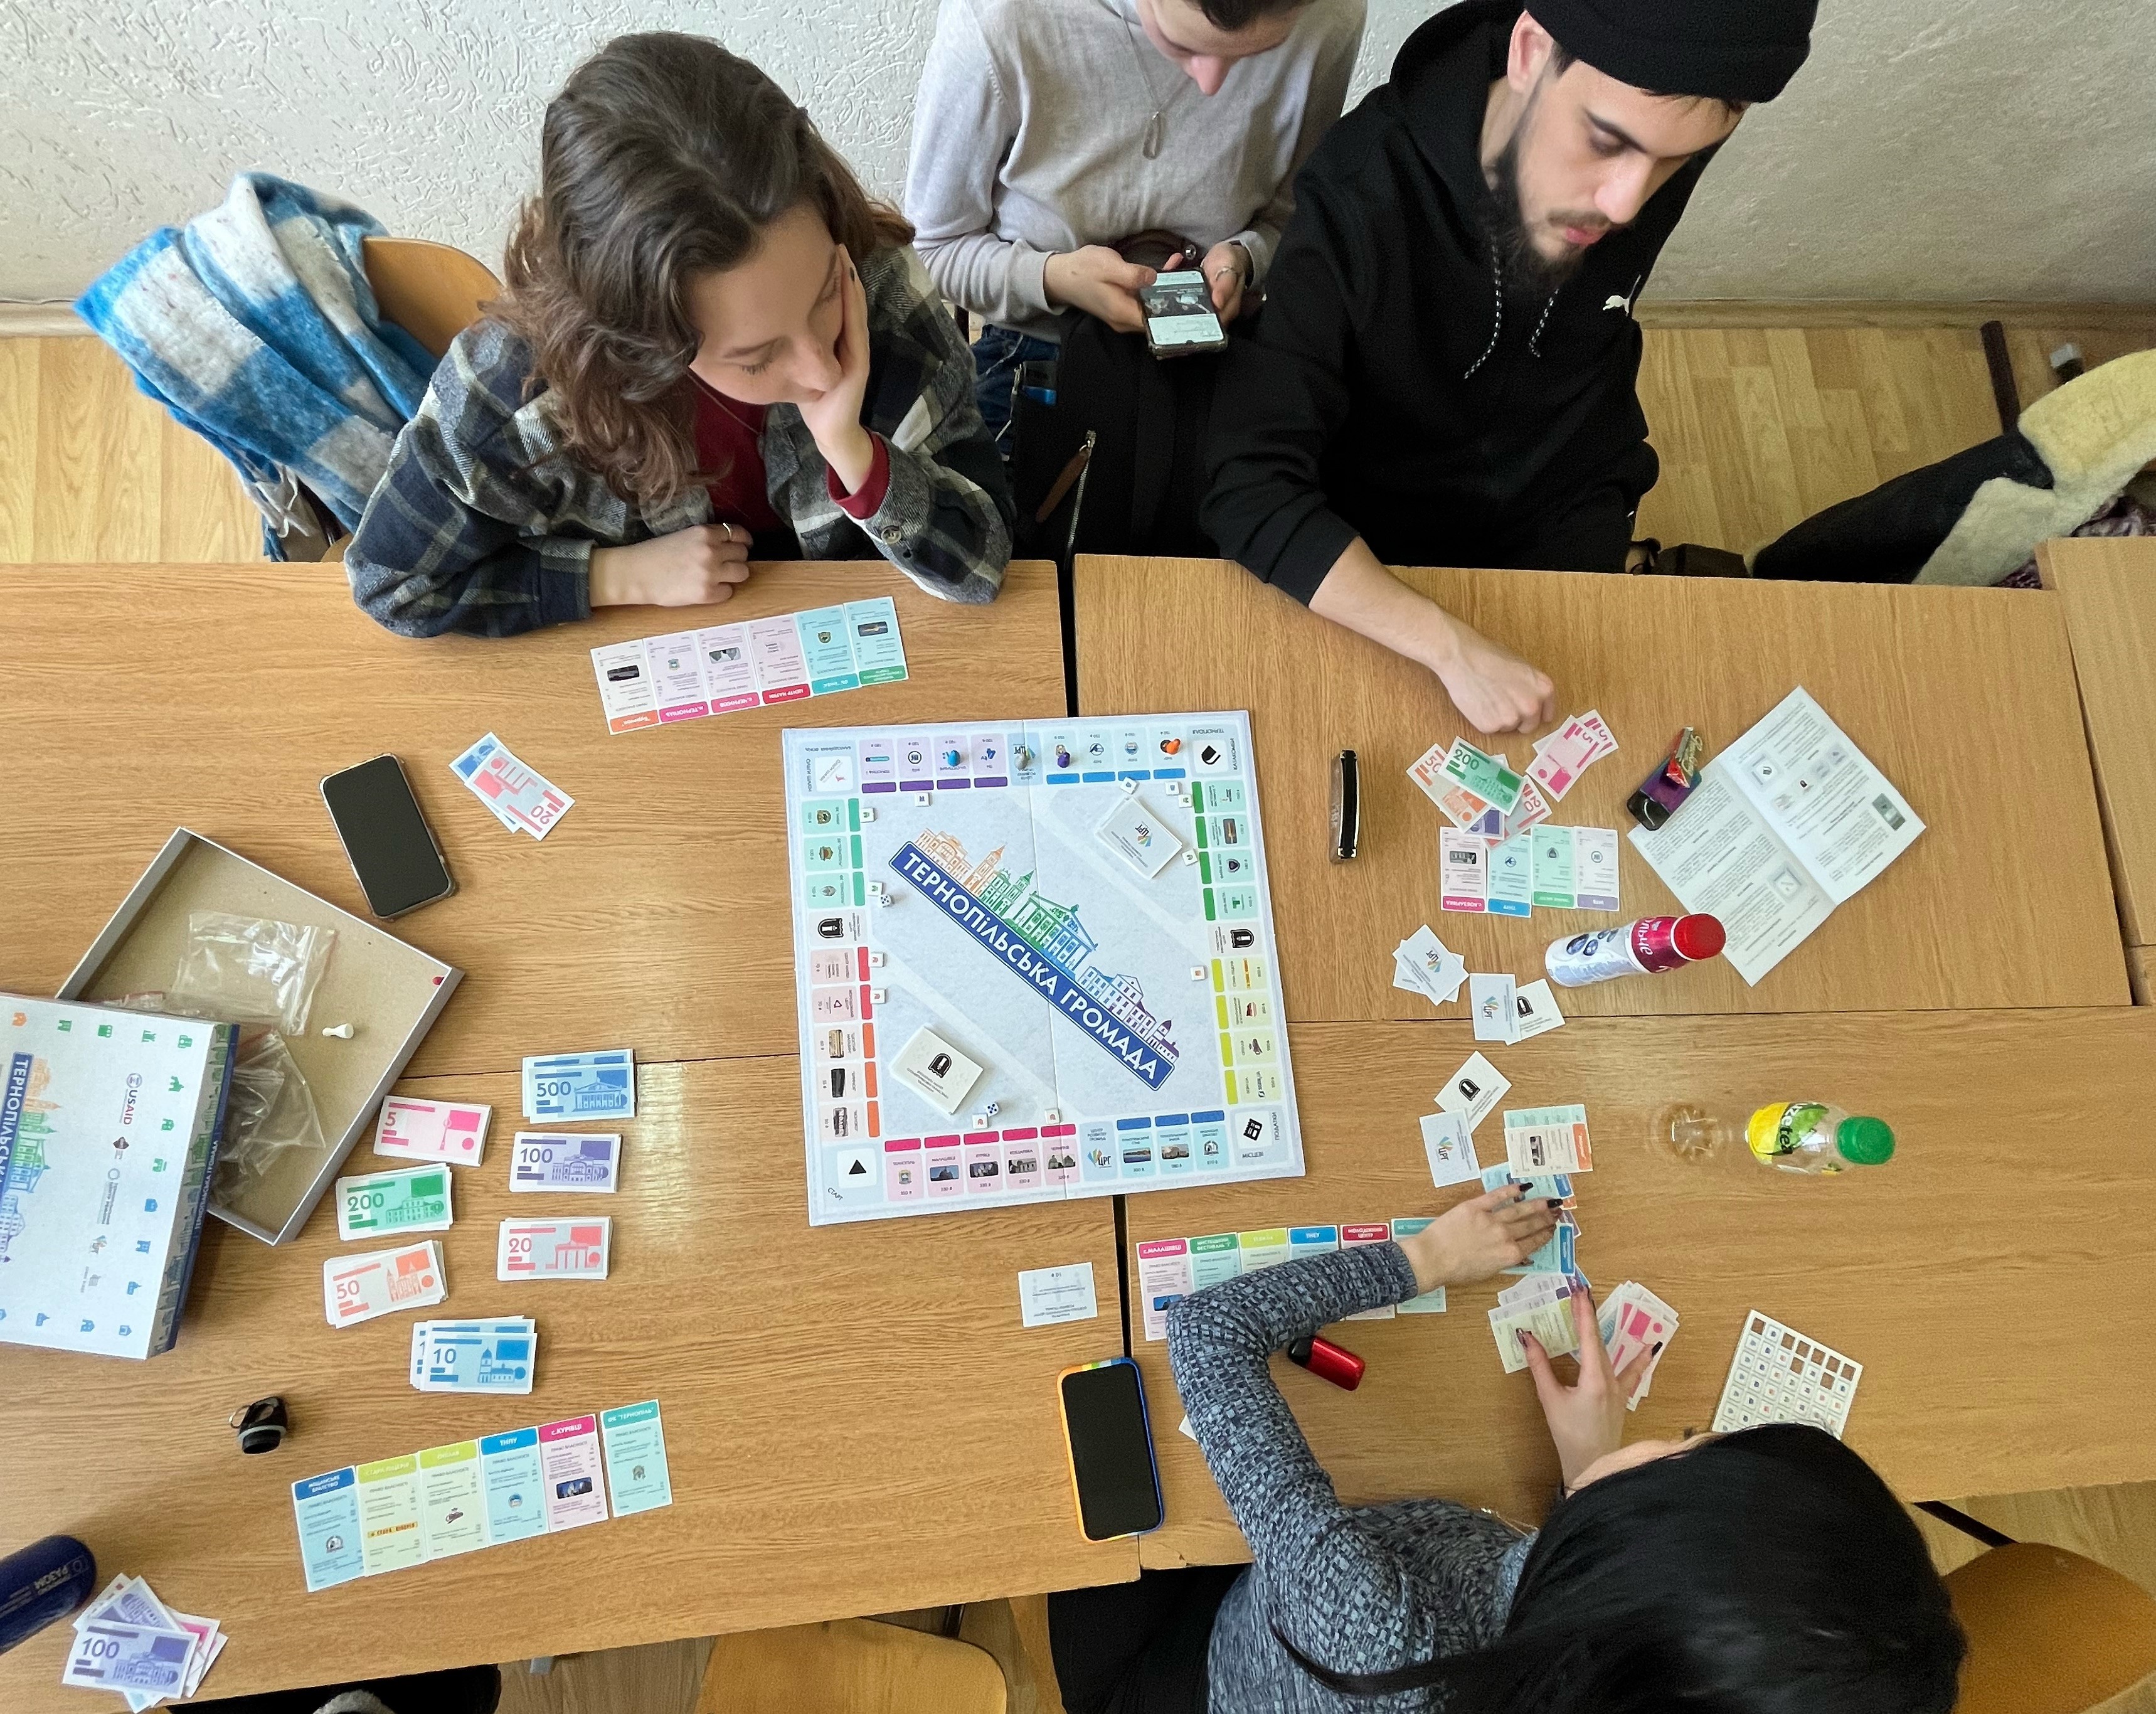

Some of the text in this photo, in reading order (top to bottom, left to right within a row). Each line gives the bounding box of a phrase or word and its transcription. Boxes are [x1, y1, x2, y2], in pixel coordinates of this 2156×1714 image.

[1582, 731, 1594, 743] 5
[1598, 728, 1608, 741] 5
[1453, 749, 1480, 770] 200
[1524, 796, 1542, 812] 20
[530, 805, 555, 825] 20
[1135, 824, 1149, 837] ЦРГ
[1426, 950, 1439, 962] ЦРГ
[903, 853, 1159, 1080] ТЕРНОПІЛЬСЬКА ГРОМАДА
[1484, 1006, 1493, 1019] ЦРГ
[536, 1080, 571, 1097] 500
[123, 1090, 138, 1125] USAID
[385, 1112, 396, 1127] 5
[1272, 1112, 1280, 1141] ПОДАТКИ
[1780, 1127, 1793, 1154] tea
[520, 1148, 553, 1164] 100
[1098, 1156, 1111, 1166] ЦРГ
[1438, 1146, 1448, 1161] ЦРГ
[827, 1186, 844, 1201] СТАРТ
[347, 1193, 384, 1212] 200
[508, 1237, 532, 1254] 20
[336, 1279, 359, 1300] 50
[433, 1348, 456, 1365] 10
[82, 1637, 120, 1659] 100
